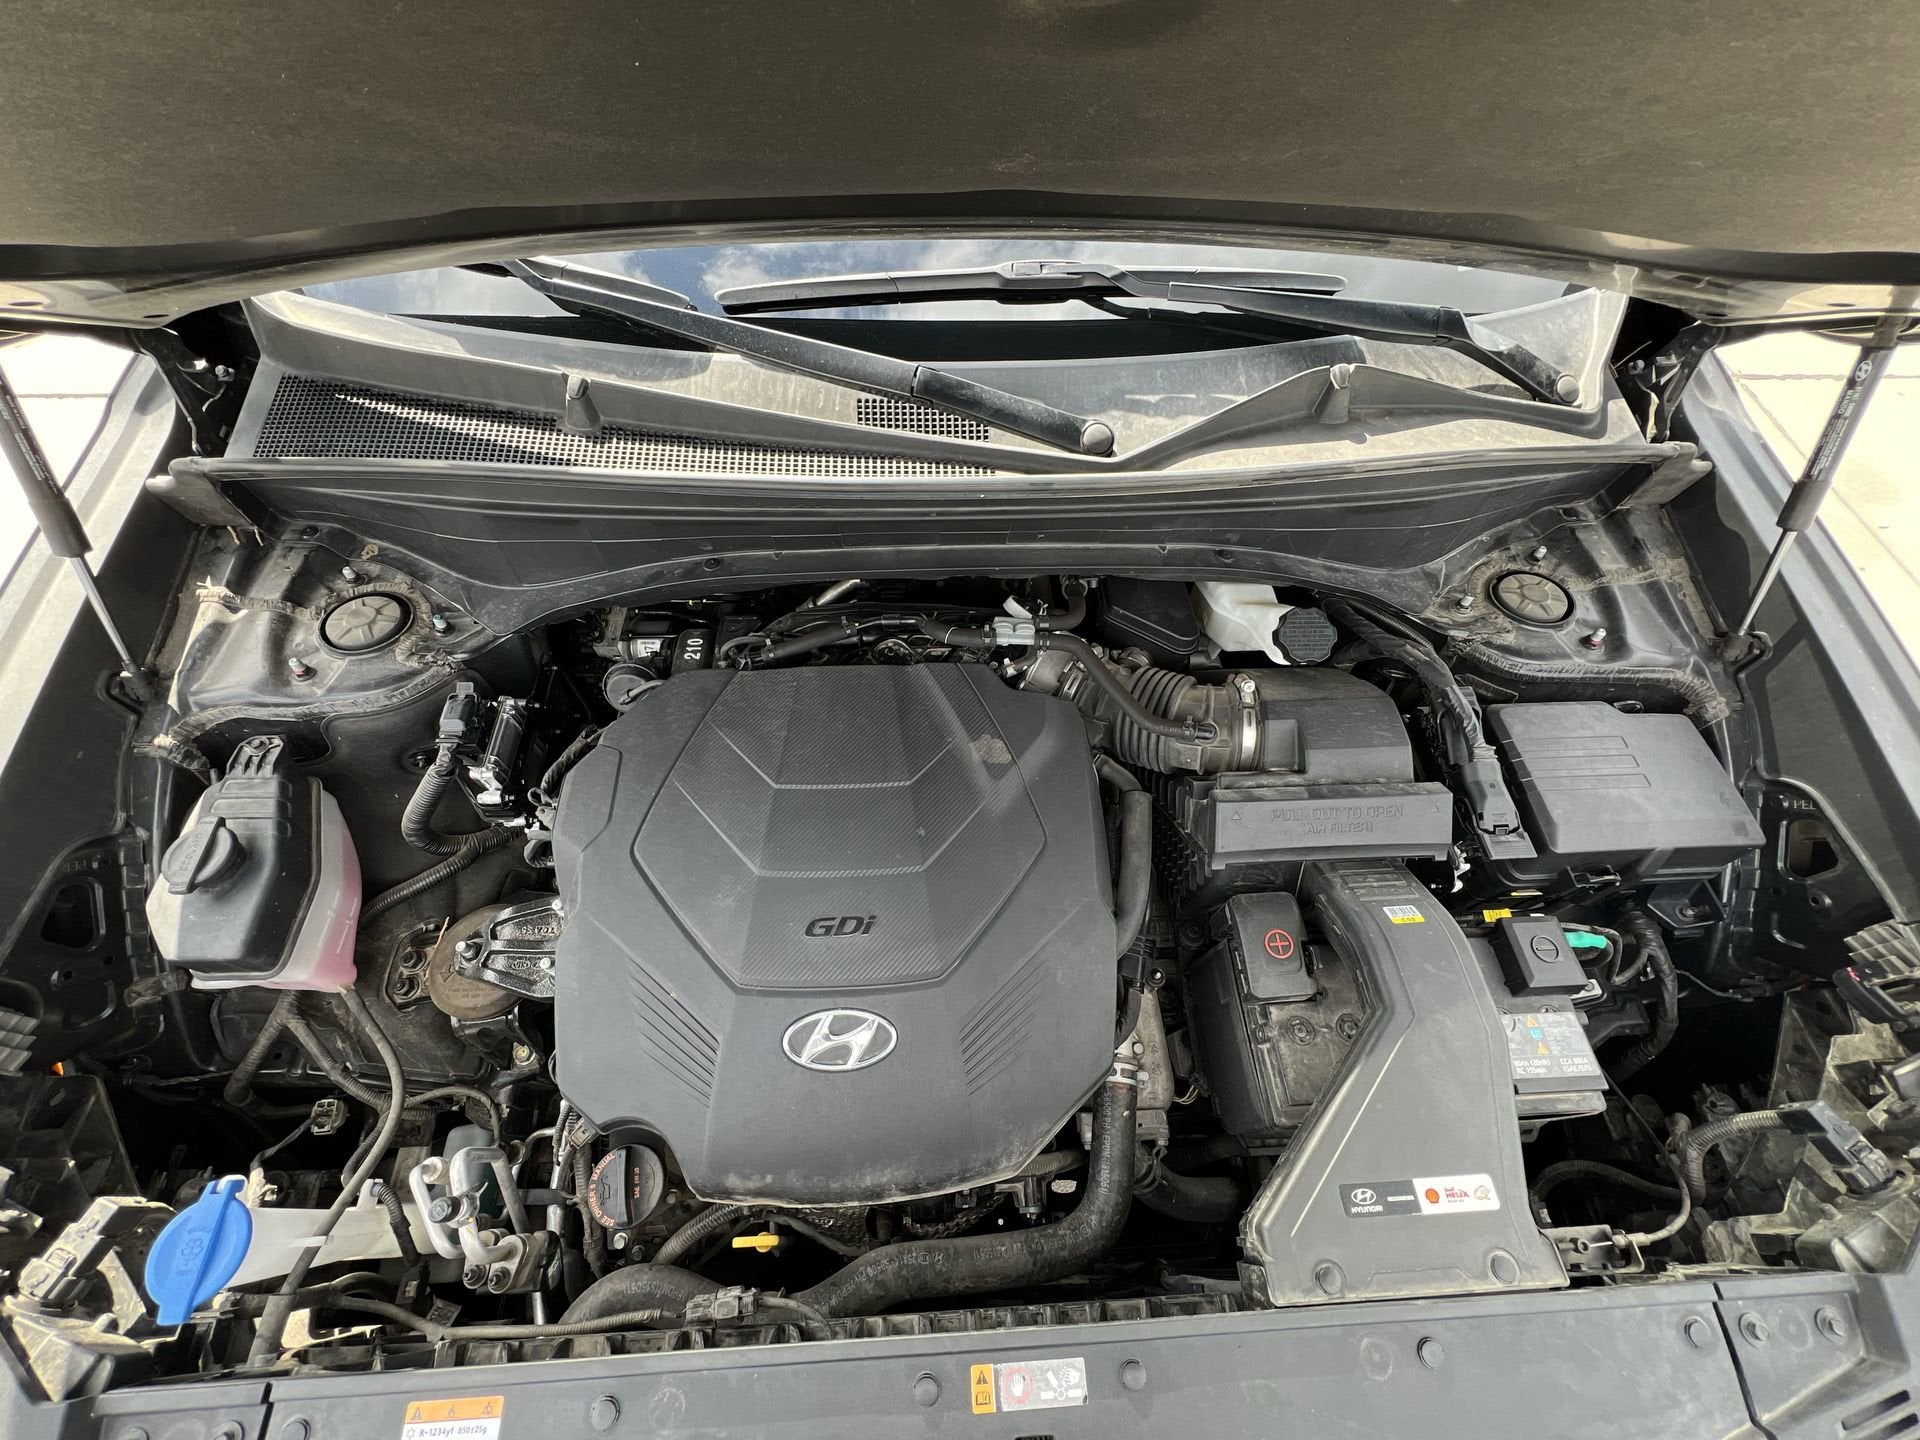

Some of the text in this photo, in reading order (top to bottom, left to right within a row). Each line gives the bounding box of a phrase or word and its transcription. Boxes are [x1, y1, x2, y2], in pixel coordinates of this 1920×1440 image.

[684, 638, 704, 660] 210
[1271, 806, 1404, 822] PULL OUT TO OPEN
[804, 915, 878, 938] GDi
[592, 1152, 616, 1181] MANUAL
[1351, 1205, 1384, 1213] HYUNDAI
[600, 1215, 615, 1227] SEE
[419, 1425, 455, 1438] R-1234yf
